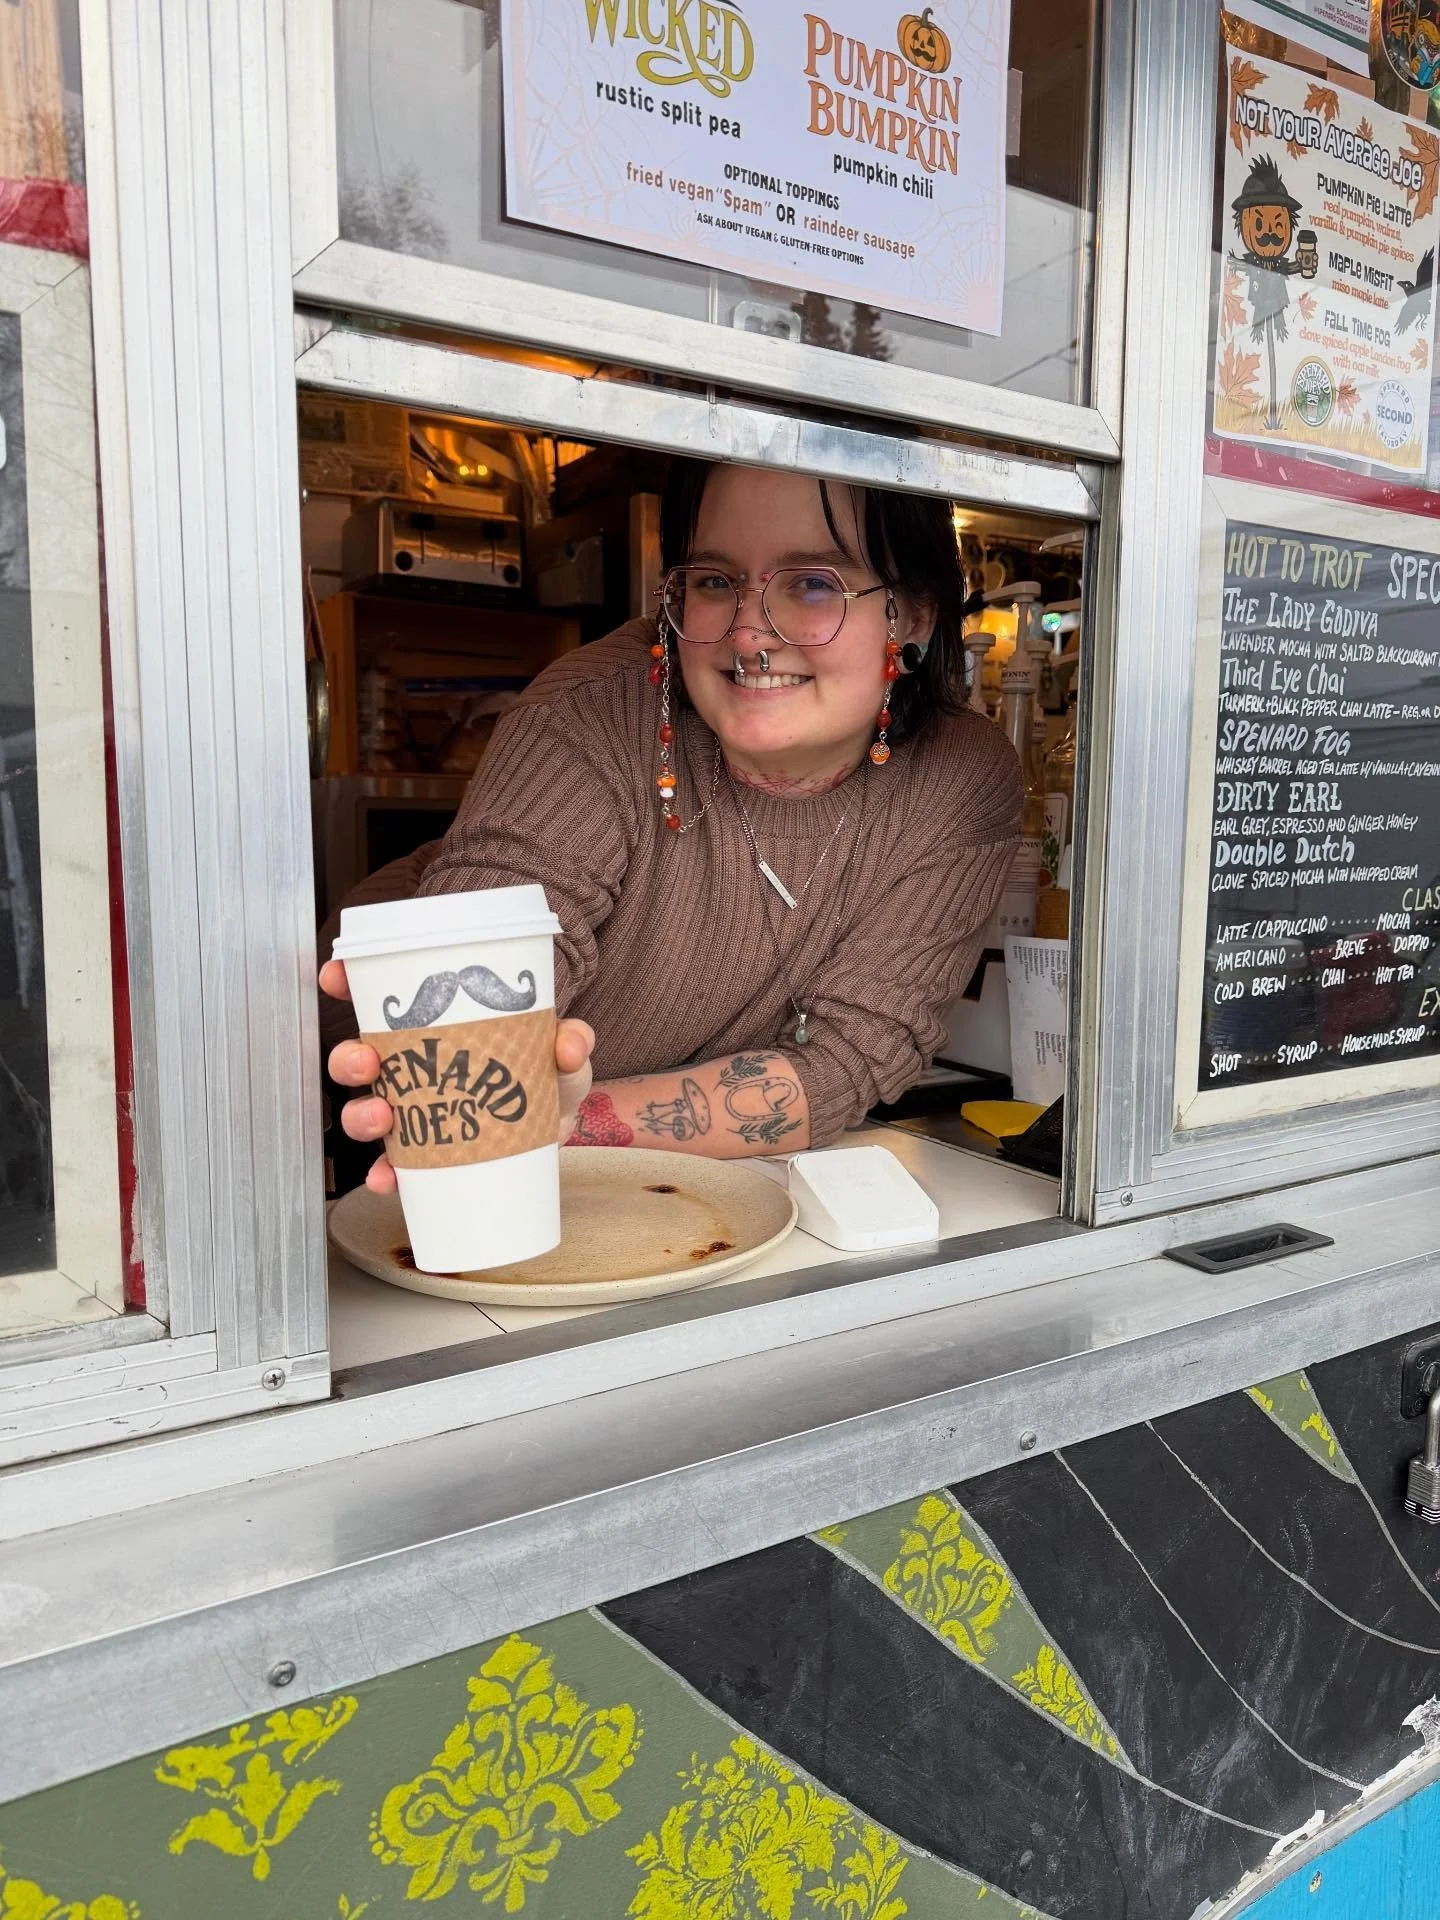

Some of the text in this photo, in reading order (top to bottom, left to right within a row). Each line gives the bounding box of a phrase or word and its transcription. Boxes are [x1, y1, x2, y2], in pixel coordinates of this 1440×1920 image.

[803, 14, 962, 124] PUMPKIN
[596, 81, 741, 138] rustic split pea
[1235, 94, 1269, 132] NOT
[1272, 107, 1322, 149] YOUR
[807, 80, 960, 175] BUMPKIN
[724, 164, 840, 210] OPTIONAL TOPPINGS
[834, 154, 933, 199] pumpkin chili
[626, 162, 663, 189] fried
[669, 176, 714, 202] vegan
[776, 204, 796, 225] OR
[804, 215, 859, 242] raindeer
[863, 232, 915, 259] sausage
[1324, 200, 1341, 215] real
[715, 217, 743, 234] ABOUT
[745, 226, 772, 242] VEGAN
[831, 249, 864, 265] OPTIONS
[1309, 215, 1414, 262] vanilla & pumpkin pie spices
[1377, 405, 1412, 425] SECOND
[1227, 532, 1372, 592] HOT TO TROT
[1224, 587, 1378, 640] THE LADY GODIVA
[1221, 631, 1275, 655] LAVENDER
[1279, 637, 1310, 658] MOCHA
[1315, 642, 1337, 660] WITH
[1340, 642, 1374, 662] SALTED
[1376, 644, 1439, 668] BLACKCURRANT
[1223, 658, 1347, 695] Third Eye Chai
[1300, 698, 1338, 717] PEPPER
[1340, 701, 1361, 717] CHAI
[1220, 719, 1351, 756] SPENARD FOG
[1216, 756, 1257, 775] WHISKEY
[1258, 756, 1293, 776] BARREL
[1295, 760, 1318, 775] AGED
[1335, 762, 1359, 776] LATTE
[1217, 781, 1342, 813] DIRTY EARL
[1213, 819, 1239, 837] EARL
[1272, 817, 1325, 835] ESPRESSO
[1326, 818, 1346, 832] AND
[1348, 815, 1385, 834] GINGER
[1386, 813, 1418, 831] HONEY
[1215, 834, 1355, 867] Double Dutch
[1211, 864, 1418, 892] CLOVE SPICED MOCHA WITH WHIPPED CREAM
[1217, 922, 1251, 944] LATTE
[1376, 912, 1410, 931] MOCHA
[1332, 939, 1368, 960] BREVE
[1393, 935, 1429, 953] DOPPIO
[1216, 948, 1286, 972] AMERICANO
[1375, 964, 1414, 985] HOT TEA
[1214, 975, 1286, 1004] COLD BREW
[1322, 968, 1345, 987] CHAI
[1396, 1025, 1425, 1044] SYRUP
[1210, 1054, 1242, 1077] SHOT
[1277, 1041, 1318, 1064] SYRUP
[397, 1099, 480, 1147] JOE'S
